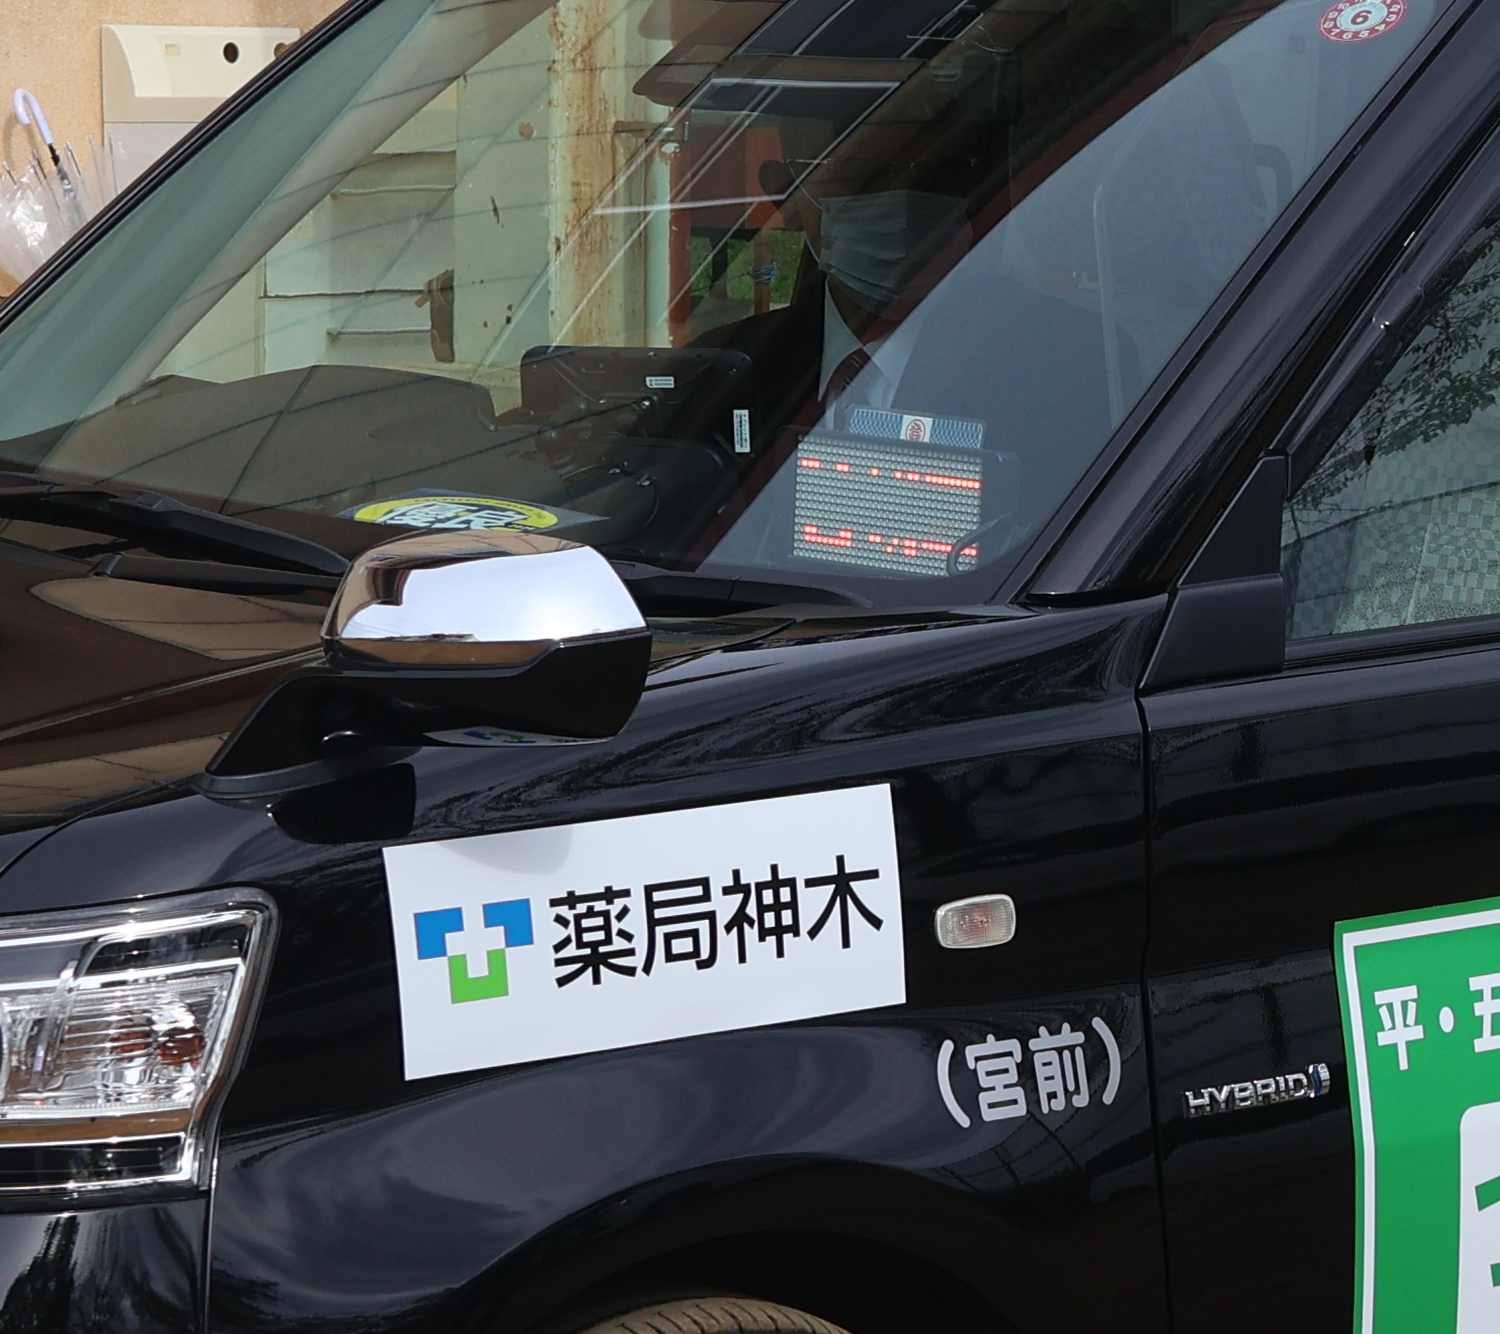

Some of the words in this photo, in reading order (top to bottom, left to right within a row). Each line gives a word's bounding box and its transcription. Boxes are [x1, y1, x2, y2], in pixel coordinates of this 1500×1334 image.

[1350, 10, 1372, 25] 6
[548, 854, 884, 989] 薬局神木
[1184, 1072, 1310, 1119] HYBRID
